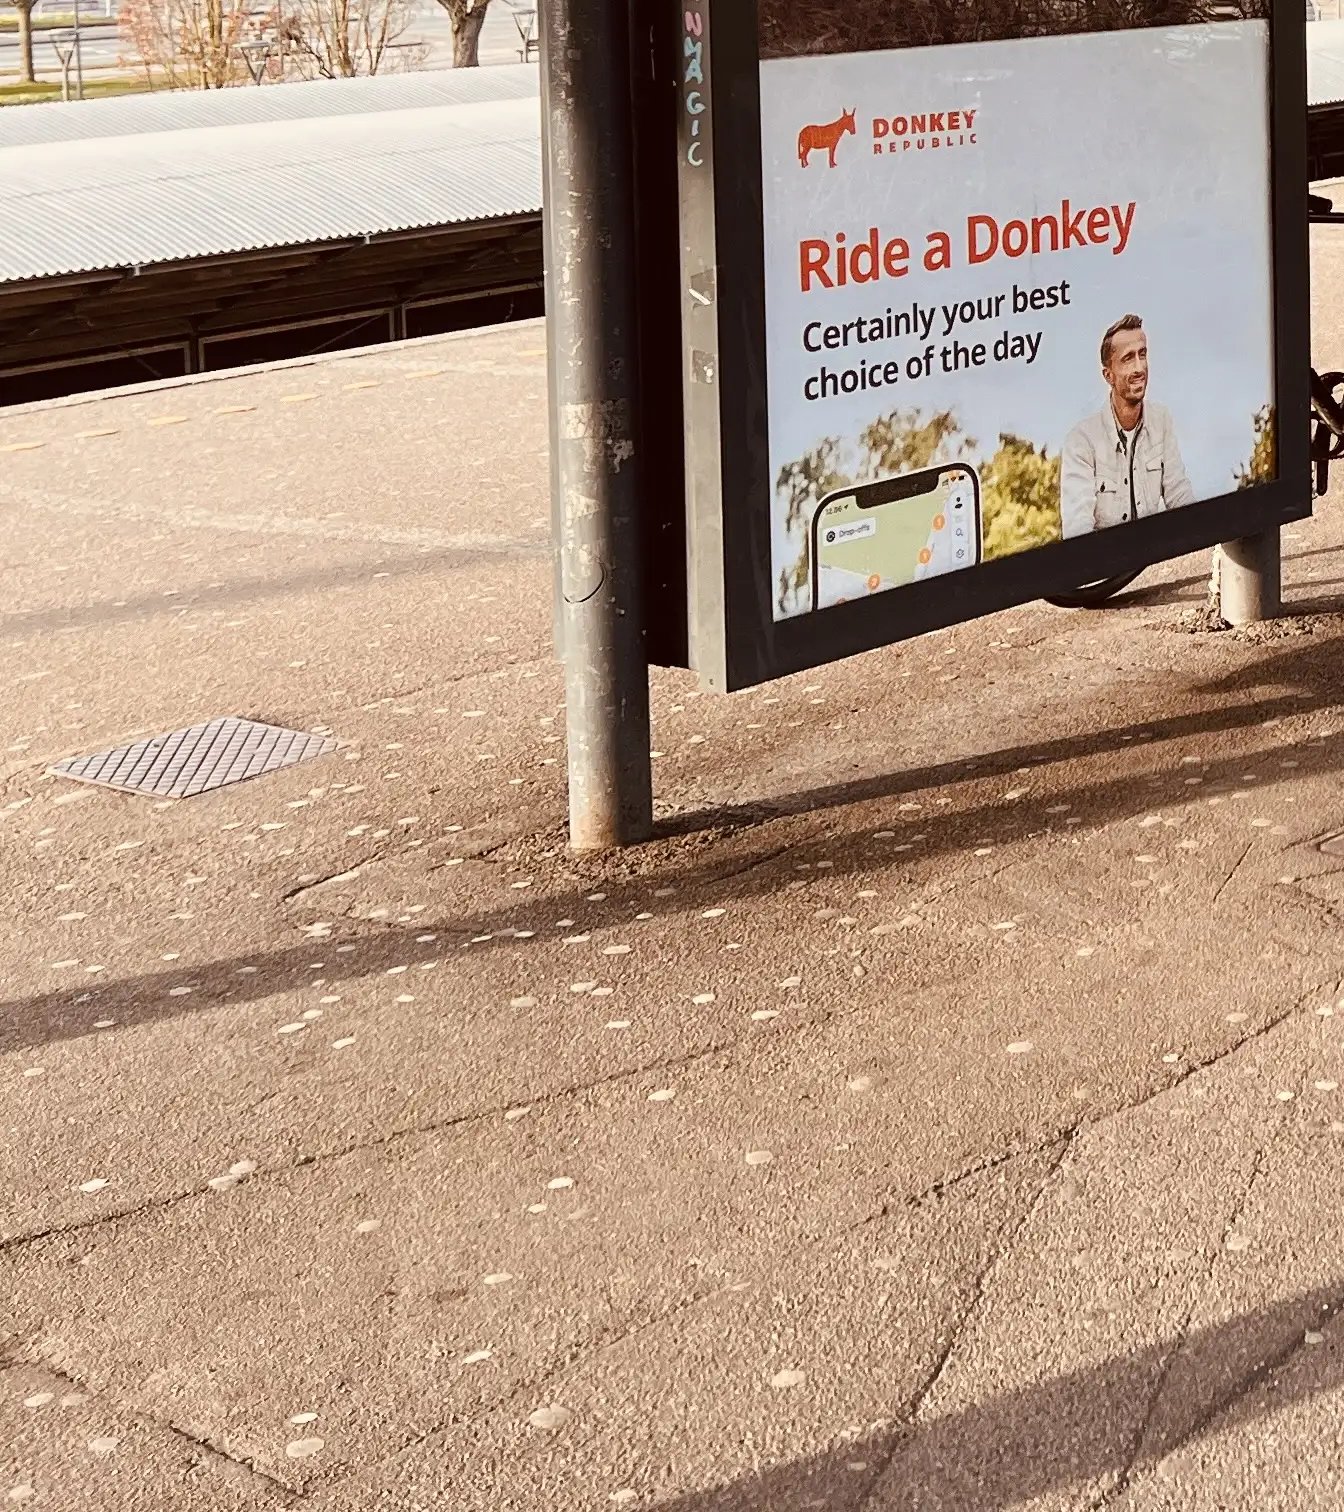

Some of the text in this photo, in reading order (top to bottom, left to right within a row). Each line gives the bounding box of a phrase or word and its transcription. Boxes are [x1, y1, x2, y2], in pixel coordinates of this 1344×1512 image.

[683, 36, 706, 167] MAGIC
[872, 109, 977, 138] DONKEY
[873, 133, 977, 155] REPUBLIC
[800, 199, 1136, 292] Ride a Donkey
[803, 280, 1071, 352] Certainly your best
[804, 330, 1043, 401] choice of the day
